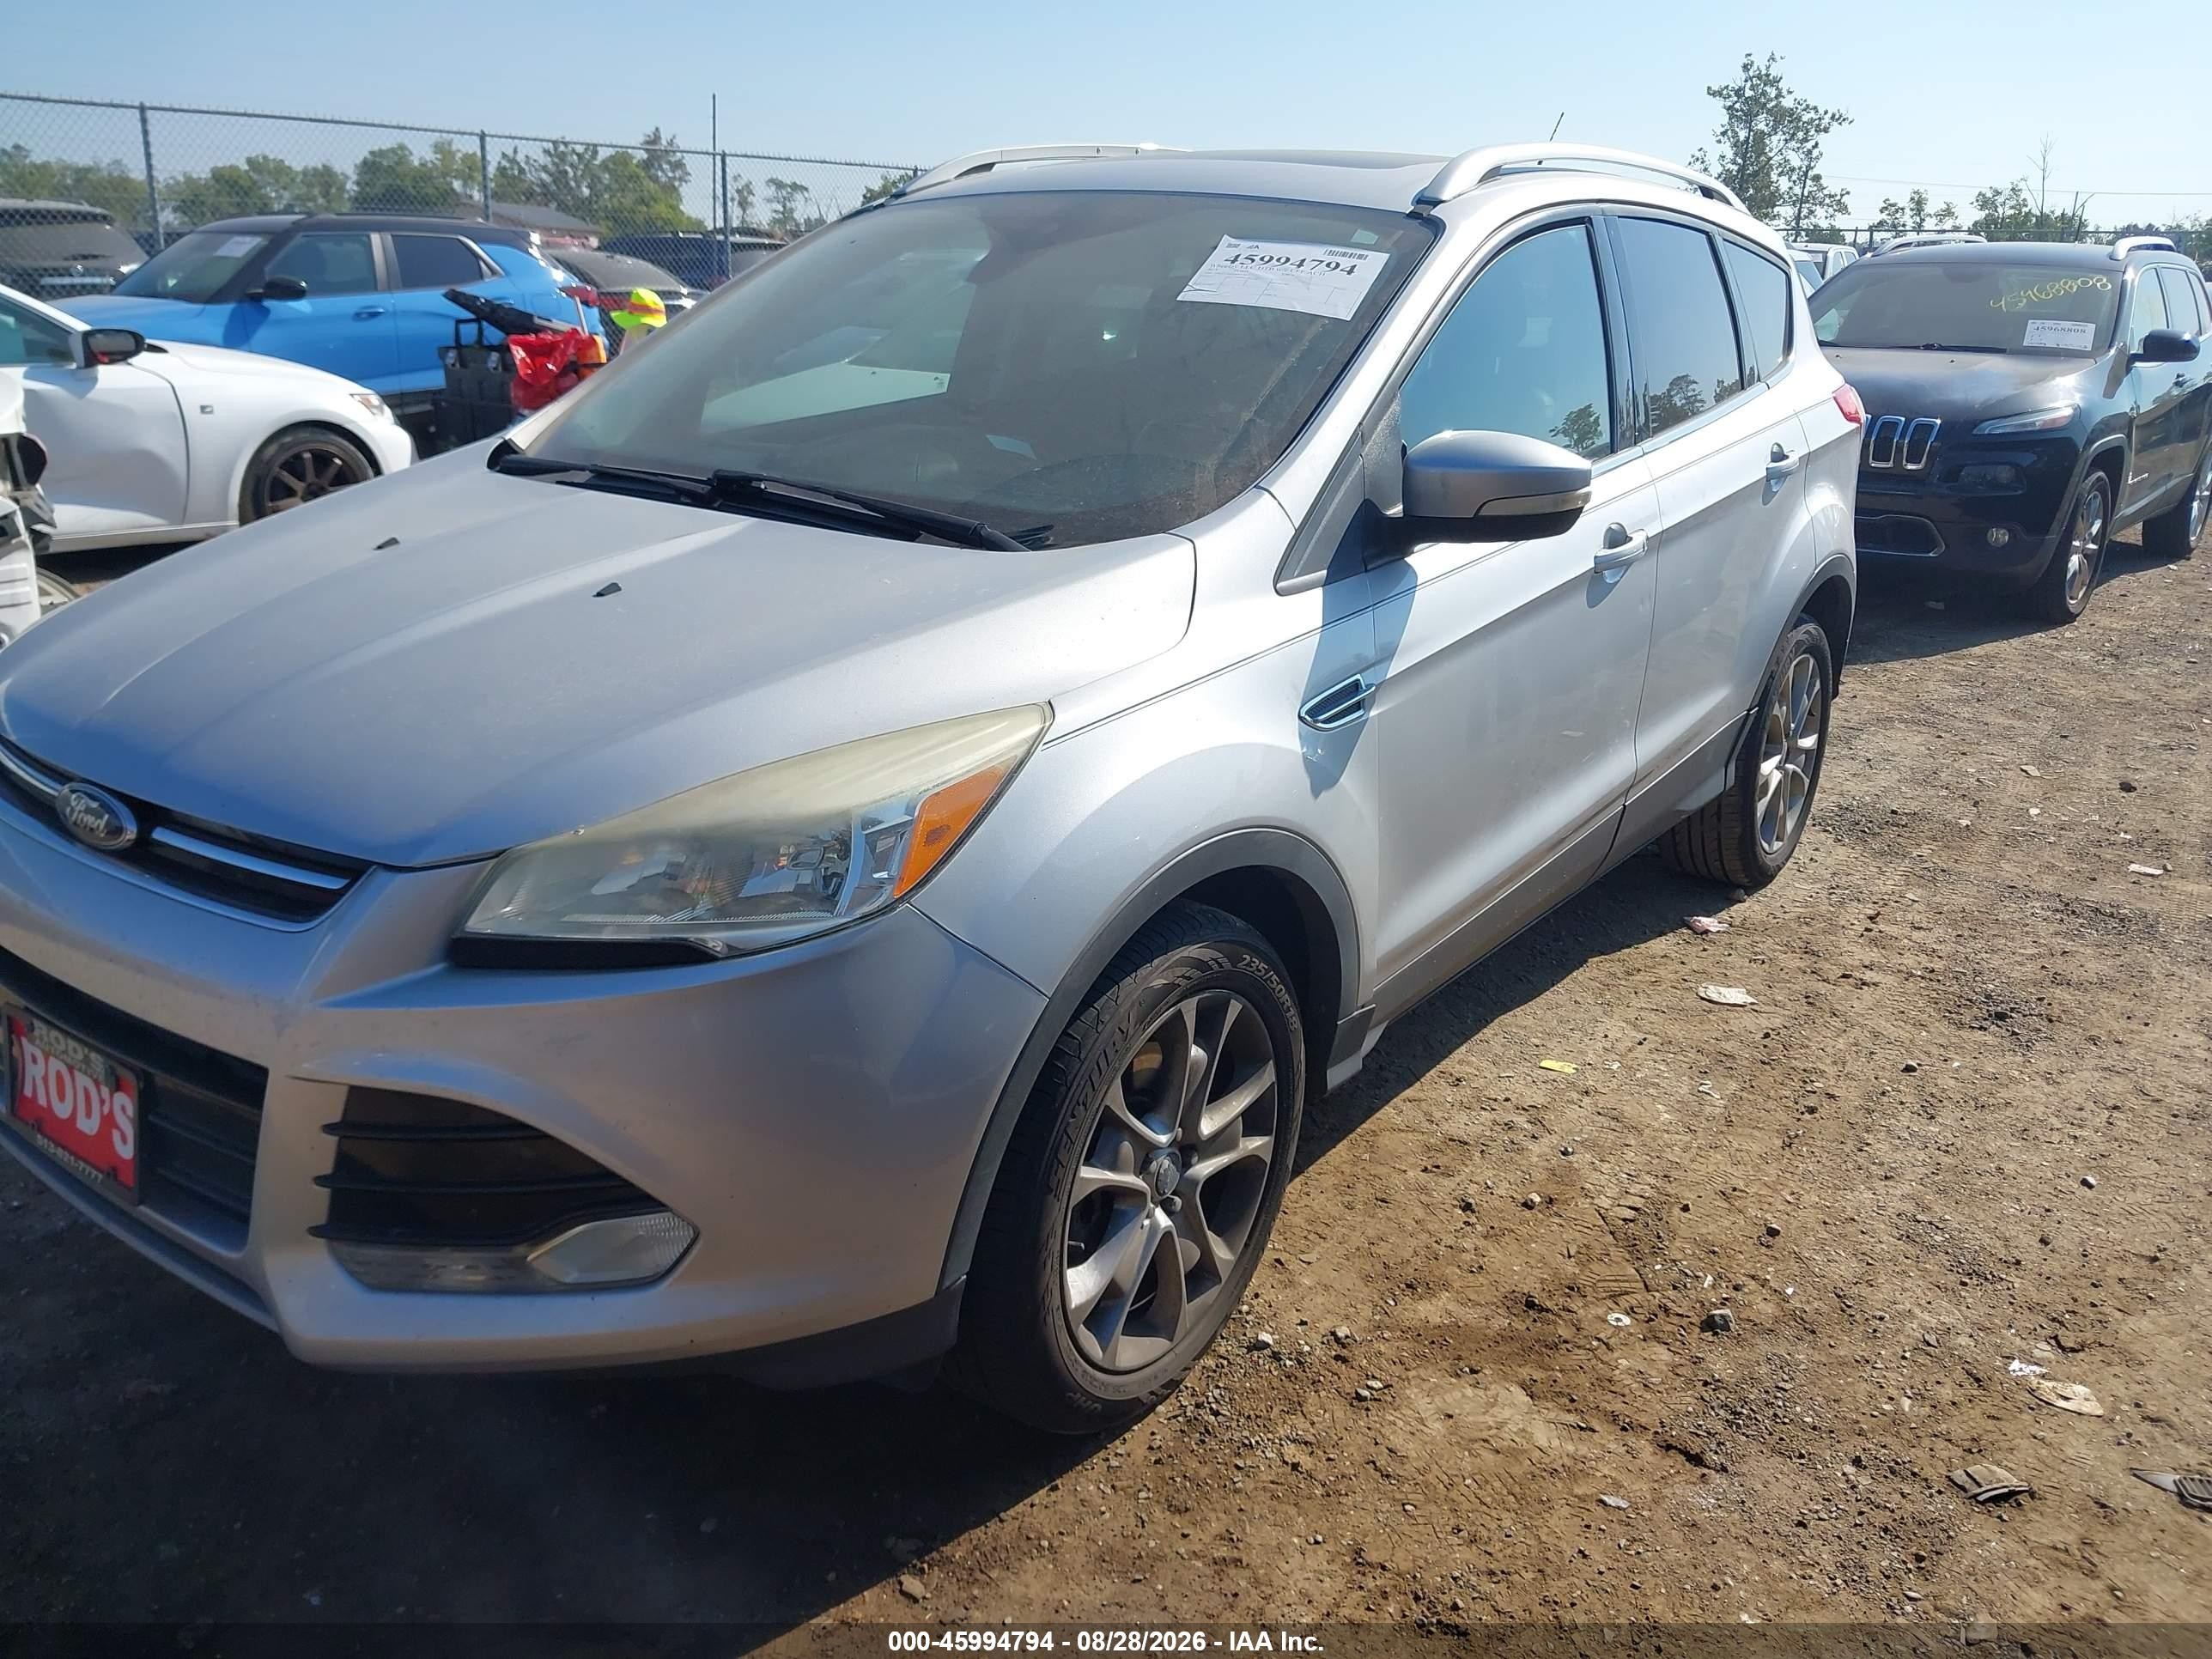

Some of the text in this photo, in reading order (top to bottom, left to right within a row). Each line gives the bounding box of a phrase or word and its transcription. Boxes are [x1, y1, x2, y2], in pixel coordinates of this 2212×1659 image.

[1223, 253, 1358, 276] 45994794
[66, 792, 110, 838] Ford
[1237, 954, 1297, 1031] 235/50R18
[33, 1018, 104, 1072] ROD'S
[21, 1036, 135, 1159] ROD'S
